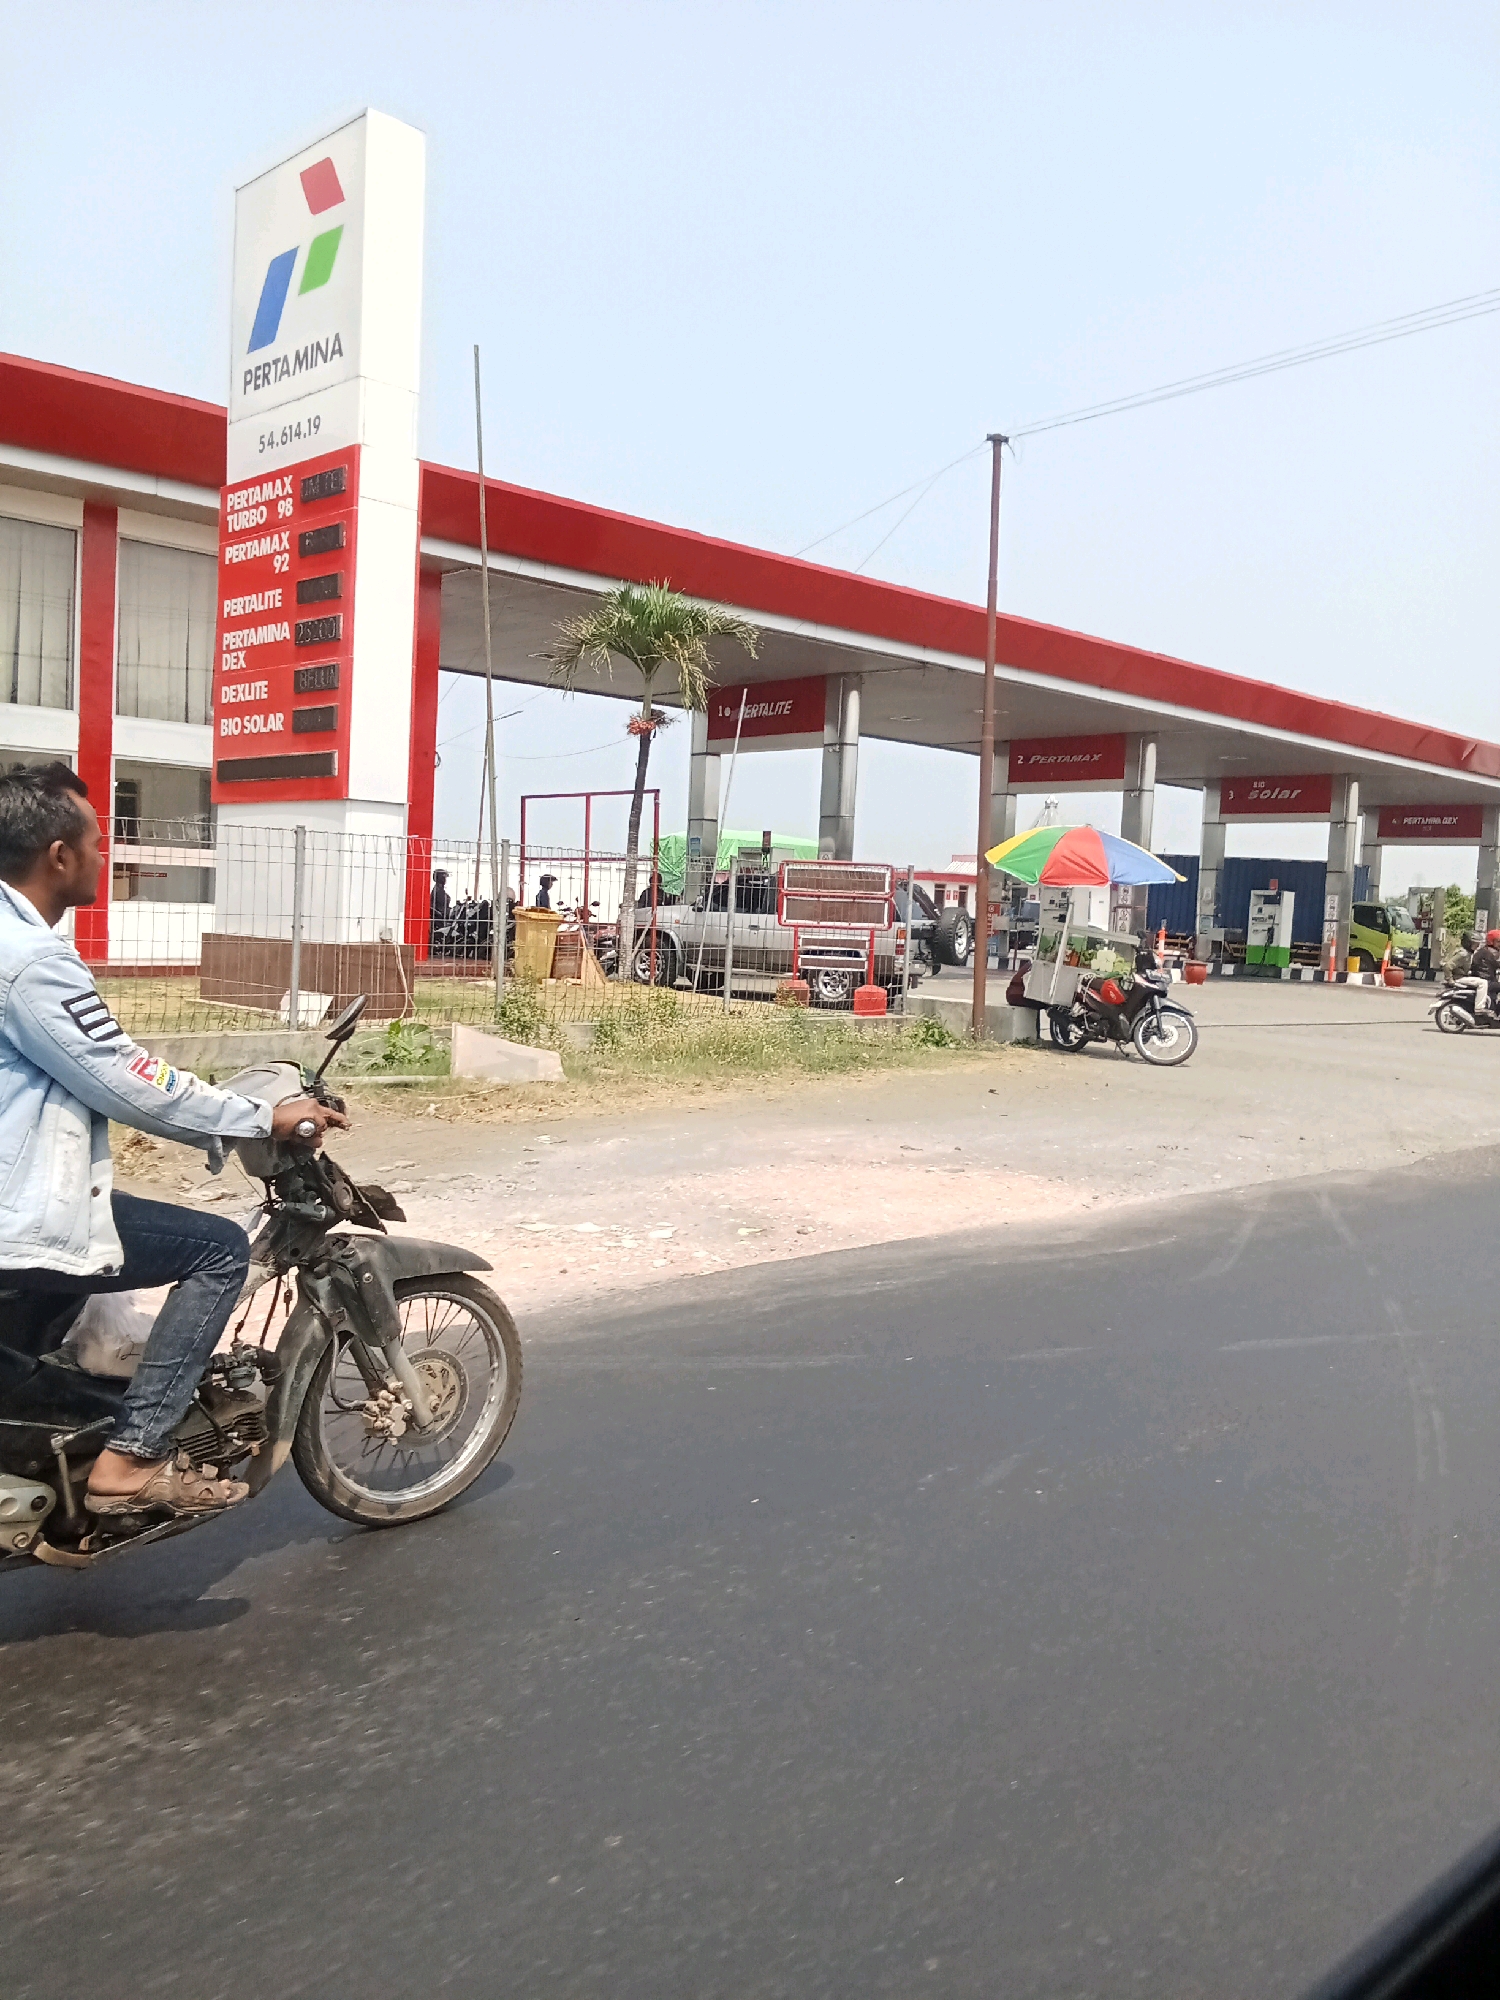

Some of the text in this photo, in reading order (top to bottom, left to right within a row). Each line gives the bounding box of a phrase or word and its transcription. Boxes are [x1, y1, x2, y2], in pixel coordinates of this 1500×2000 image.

[243, 332, 344, 395] PERTAMINA
[258, 415, 321, 454] 54.614.19
[226, 475, 293, 513] PERTAMAX
[227, 497, 293, 533] TURBO 98
[224, 531, 290, 565] PERTAMAX
[273, 553, 290, 574] 92
[223, 588, 282, 618] PERTALITE
[222, 621, 290, 651] PERTAMINA
[222, 650, 247, 671] DEX
[221, 680, 269, 704] DEXLITE
[220, 712, 285, 737] BIO SOLAR
[1017, 753, 1102, 764] 2 PERTAMAX
[1228, 790, 1234, 800] 3
